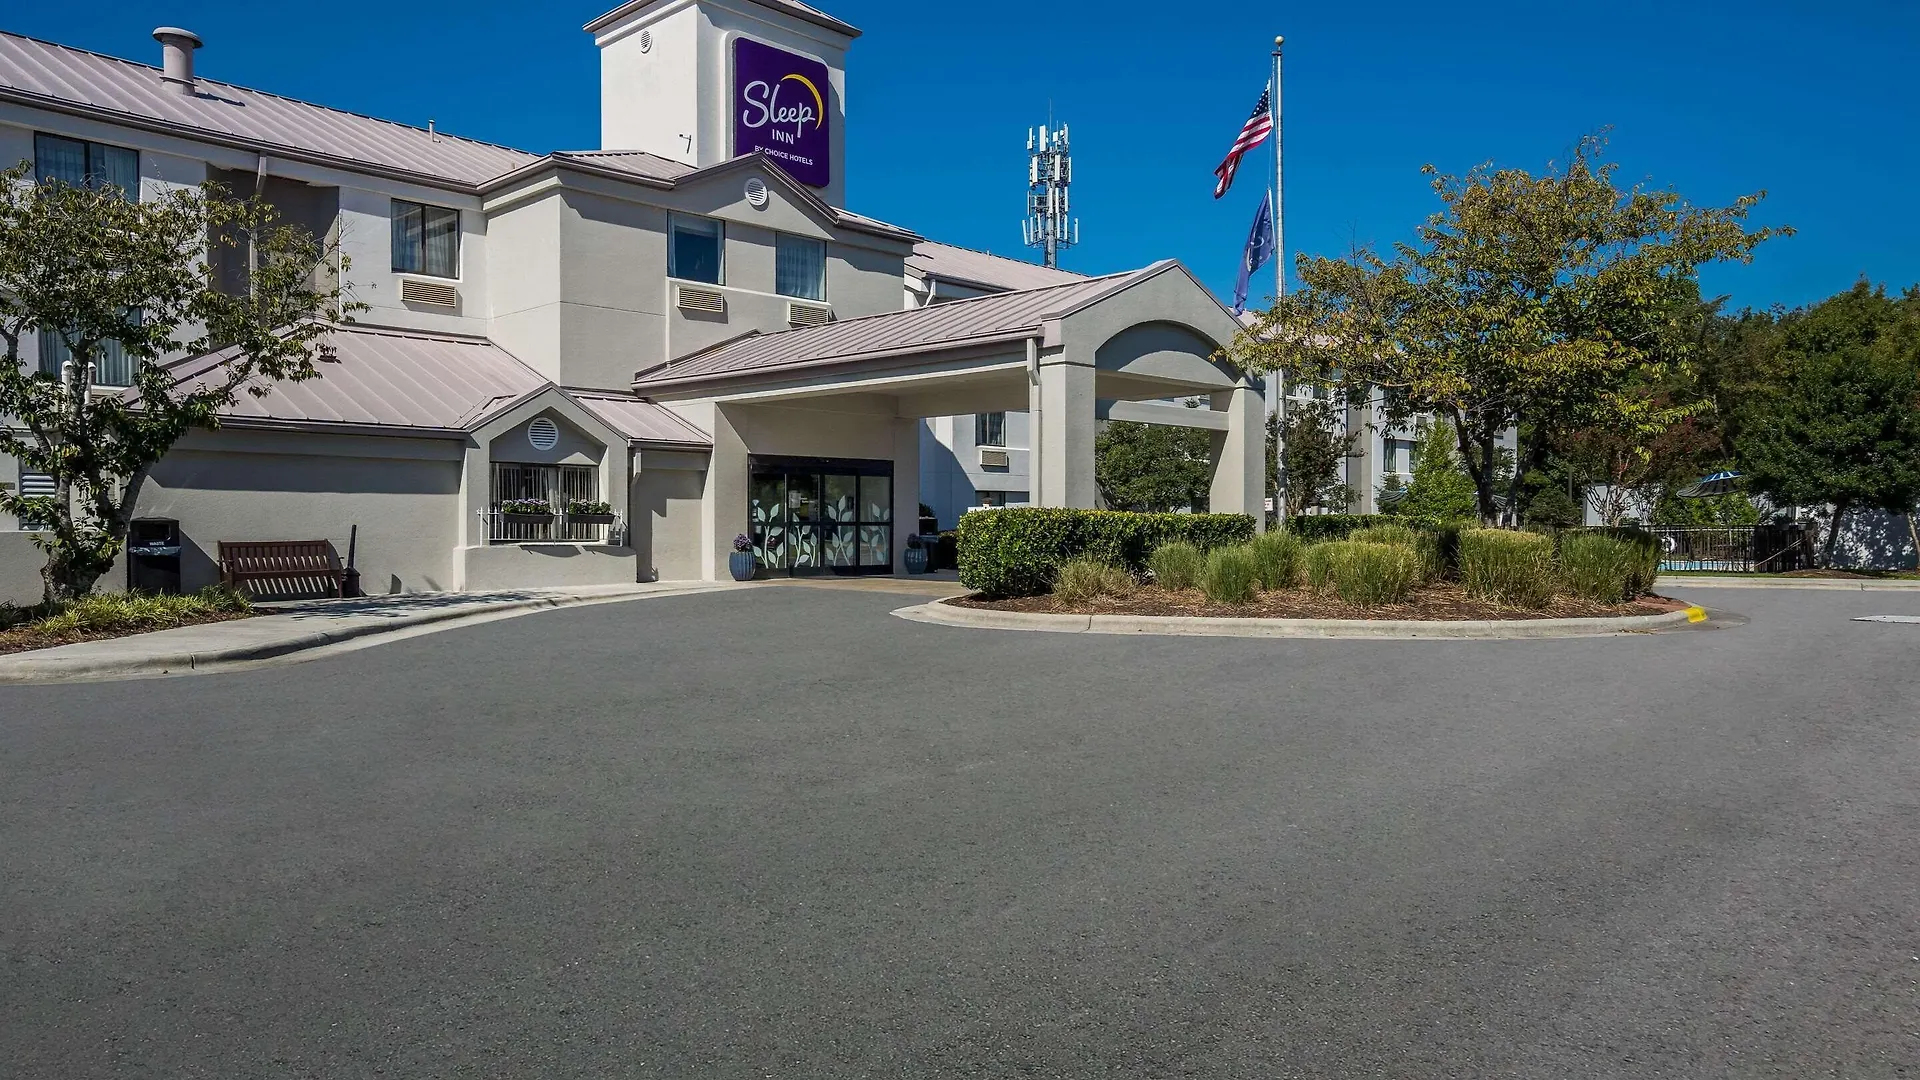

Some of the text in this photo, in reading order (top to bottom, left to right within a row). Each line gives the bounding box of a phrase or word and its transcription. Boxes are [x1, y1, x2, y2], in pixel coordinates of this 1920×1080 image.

[743, 80, 816, 138] Sleep
[772, 129, 794, 144] INN
[764, 148, 789, 160] CHOICE
[789, 154, 813, 166] HOTELS
